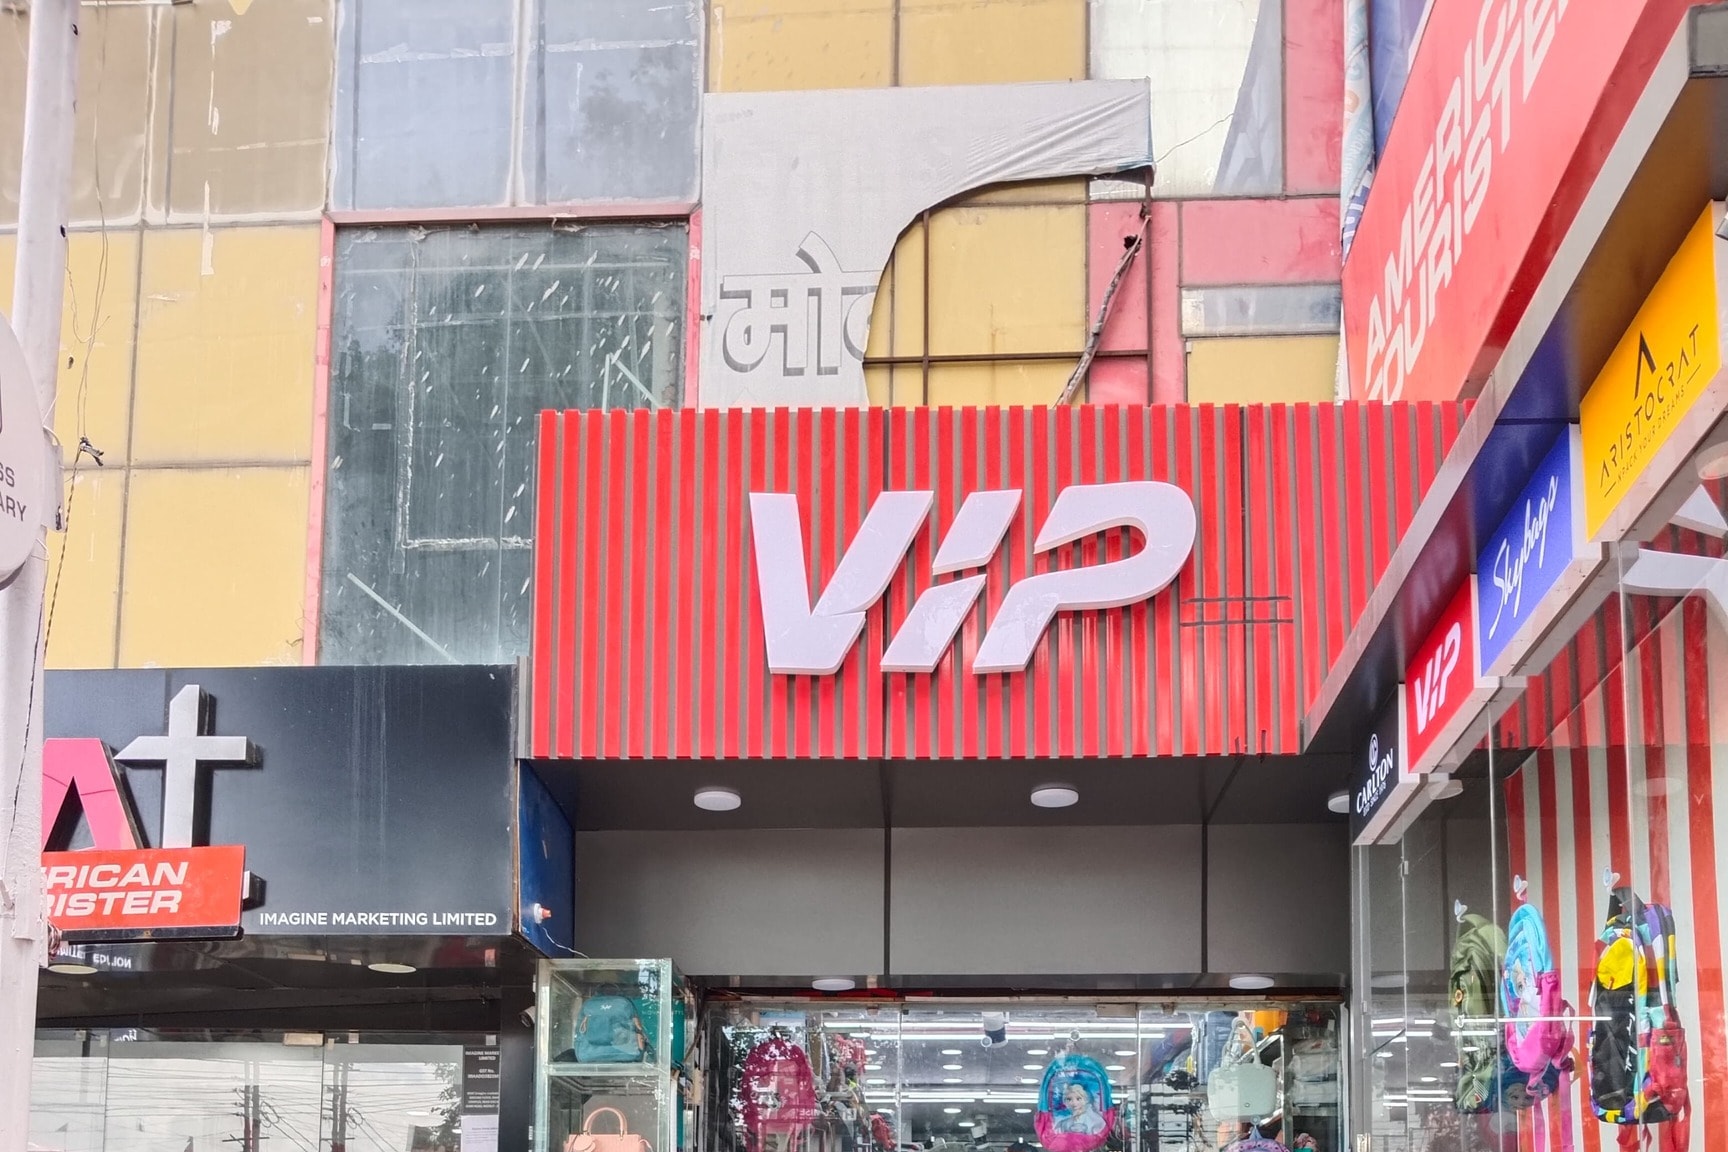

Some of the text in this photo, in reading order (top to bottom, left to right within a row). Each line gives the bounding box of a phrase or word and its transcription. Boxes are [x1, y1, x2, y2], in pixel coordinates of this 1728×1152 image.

[1369, 0, 1568, 404] OURISTE
[1600, 324, 1699, 488] ARISTOCRAT
[748, 480, 1198, 676] VIP
[1488, 475, 1559, 640] Skybags
[1414, 621, 1461, 735] VIP
[1356, 747, 1394, 814] CARLTON
[260, 912, 497, 926] IMAGINE MARKETING LIMITED
